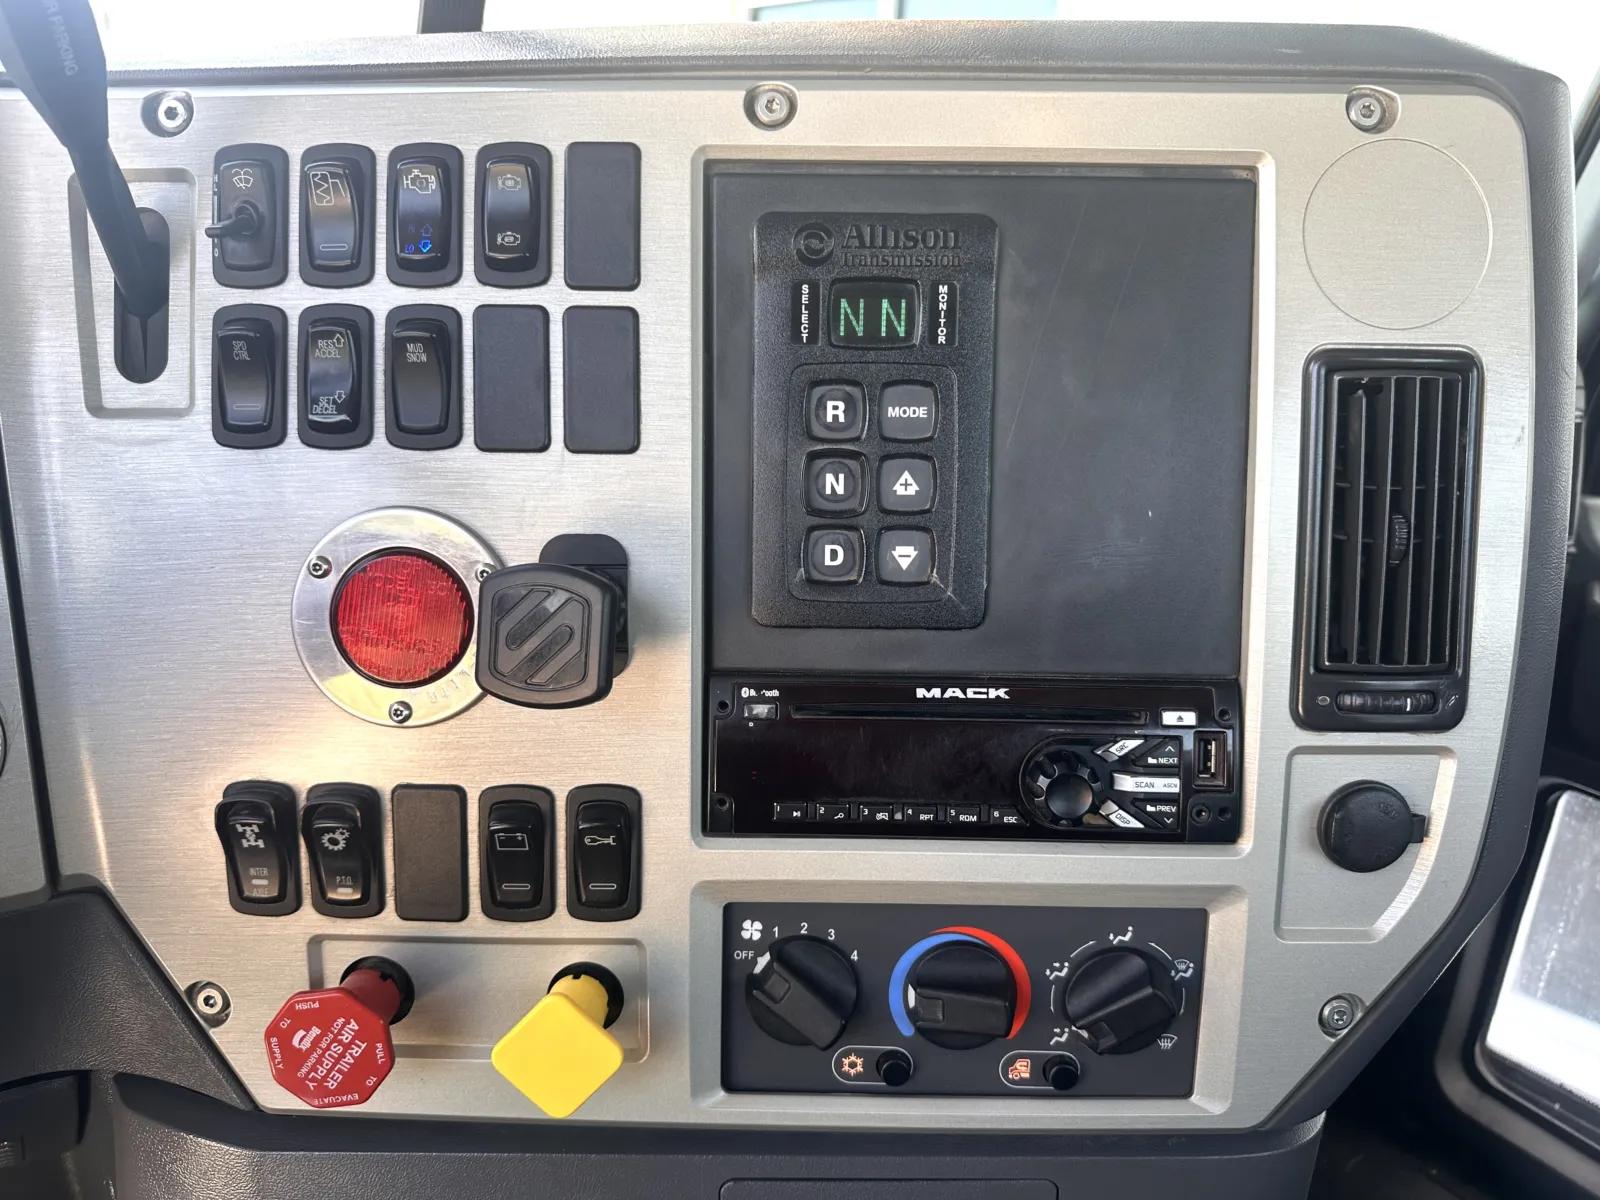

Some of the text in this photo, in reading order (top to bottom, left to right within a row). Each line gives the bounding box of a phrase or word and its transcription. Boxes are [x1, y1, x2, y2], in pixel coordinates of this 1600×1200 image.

[842, 223, 962, 250] Allison
[842, 250, 963, 268] Transmission
[801, 284, 809, 344] SELECT
[839, 298, 907, 337] N N
[937, 284, 949, 344] MONITOR
[314, 348, 342, 358] ACCEL
[406, 343, 424, 353] MUD
[233, 350, 252, 361] CTRL
[406, 352, 427, 363] SNOW
[318, 396, 335, 406] SET
[312, 404, 338, 415] DECEL
[826, 400, 846, 423] R
[887, 406, 928, 418] MODE
[825, 473, 845, 495] N
[824, 544, 845, 566] D
[915, 687, 1011, 699] MACK
[1115, 741, 1129, 754] SRC
[1134, 781, 1155, 789] SCAN
[819, 806, 825, 814] 2
[919, 814, 934, 822] RPT
[959, 814, 977, 822] RDM
[1115, 813, 1131, 825] DISP
[772, 926, 779, 938] 1
[800, 922, 808, 934] 2
[827, 928, 836, 940] 3
[733, 950, 755, 960] OFF
[850, 949, 859, 962] 4
[270, 1000, 319, 1069] PUSH TO SUPPLY
[297, 1016, 347, 1078] NOT FOR PARKING
[305, 1018, 360, 1091] AIR SUPPLY
[323, 1039, 368, 1090] TRAILER
[313, 1042, 387, 1105] PULL TO EVACUATE
